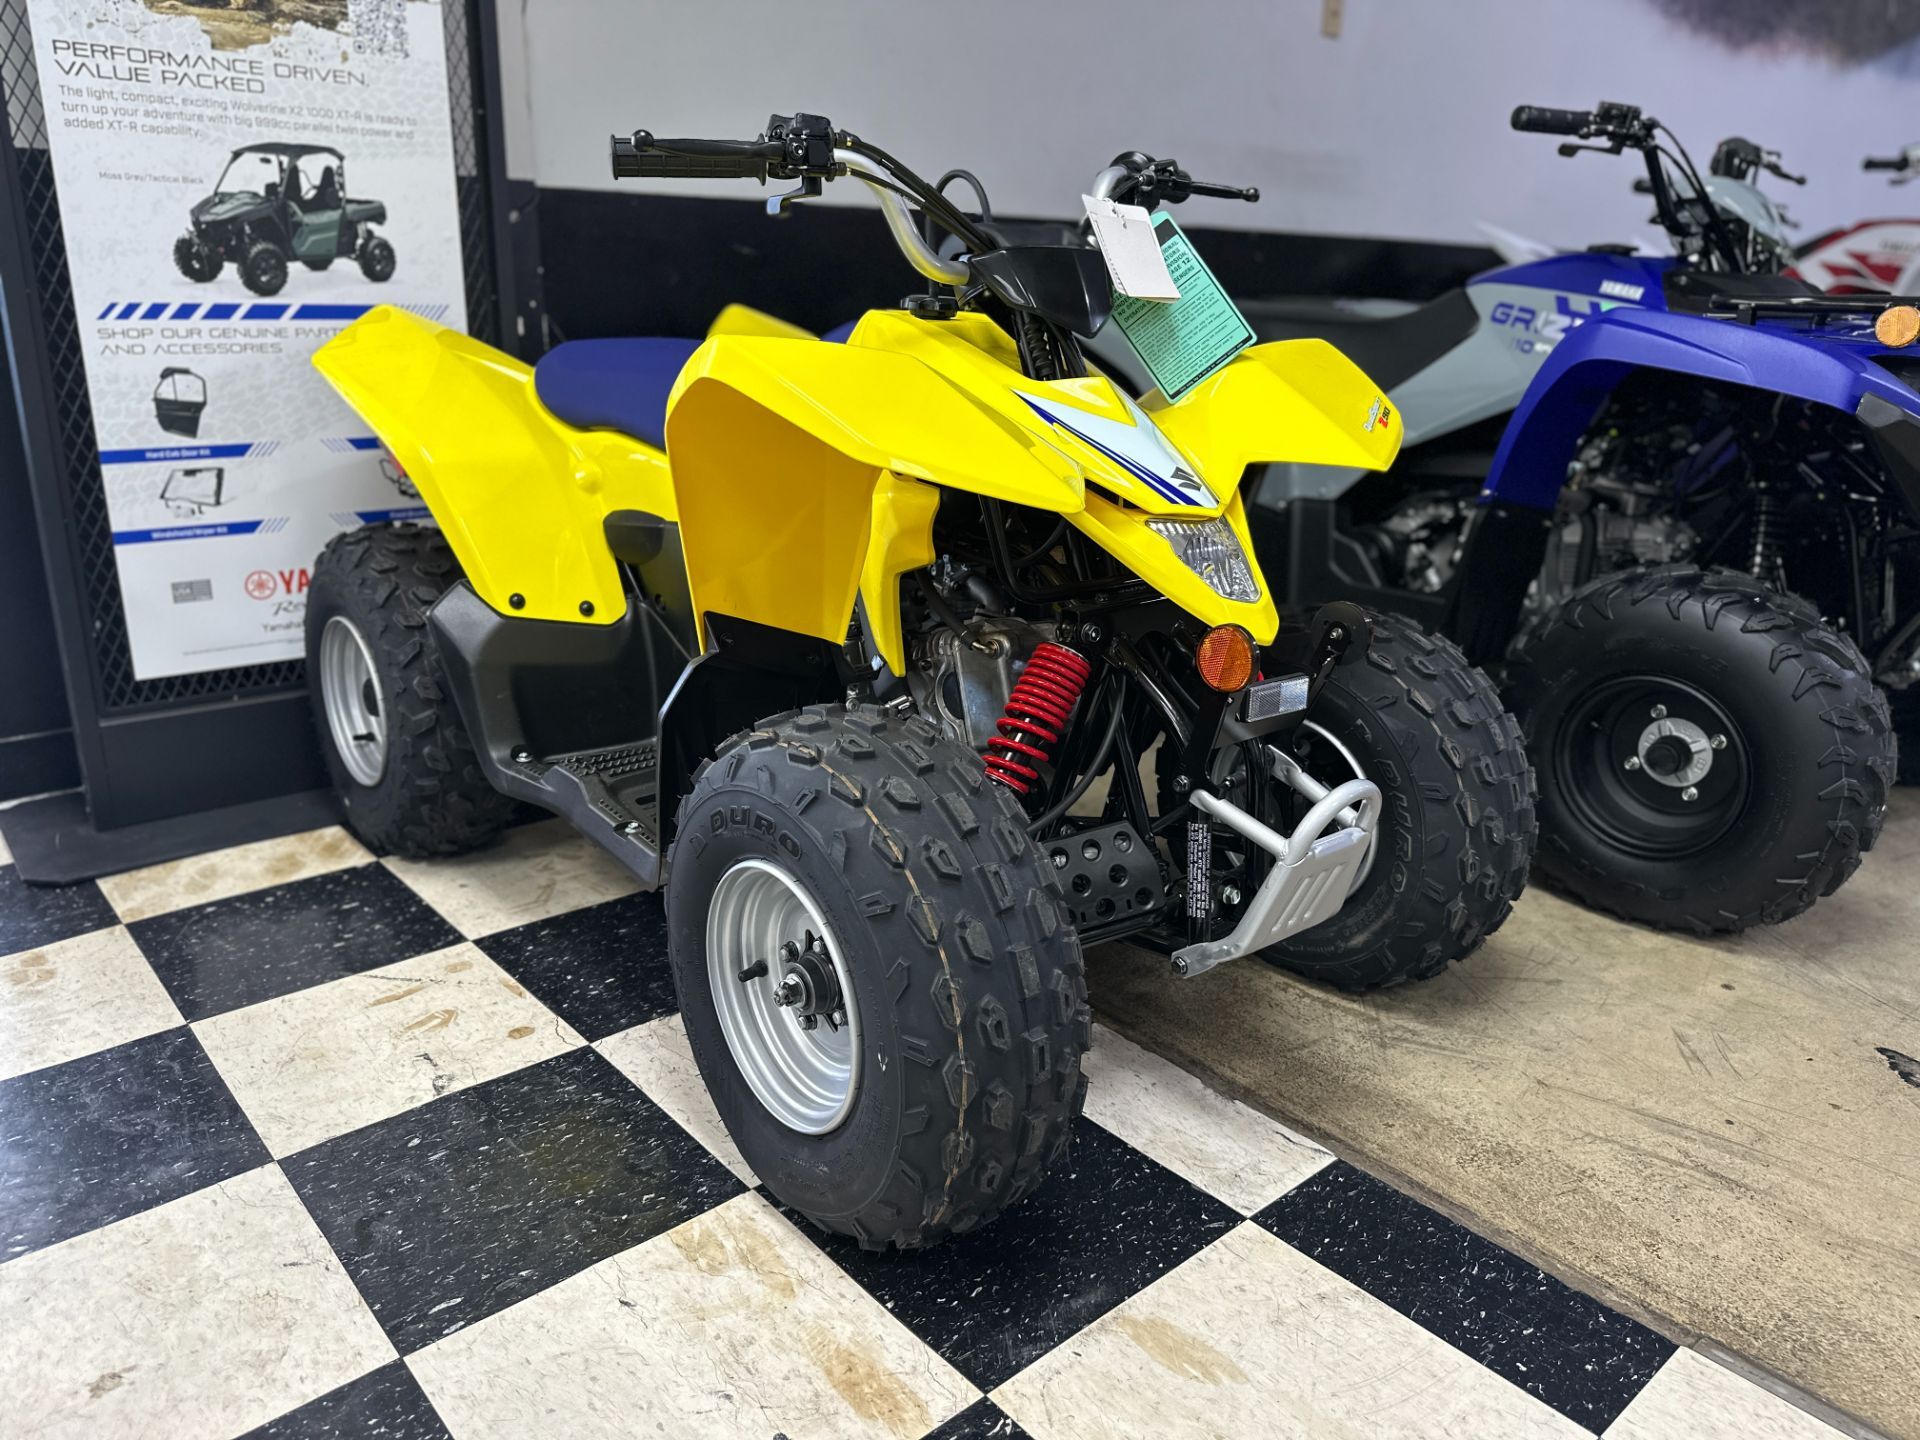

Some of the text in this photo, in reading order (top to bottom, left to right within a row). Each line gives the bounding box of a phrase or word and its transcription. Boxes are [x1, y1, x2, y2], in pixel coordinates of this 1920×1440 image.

[52, 39, 369, 87] PERFORMANCE DRIVEN.
[54, 59, 265, 94] VALUE PACKED
[58, 84, 83, 97] The
[87, 86, 118, 101] light,
[121, 90, 179, 107] compact,
[181, 96, 228, 111] exciting
[230, 101, 287, 114] Wolverine
[288, 104, 304, 116] X2
[306, 106, 334, 119] 1000
[336, 109, 364, 121] XT-R
[376, 113, 405, 126] ready
[406, 115, 418, 126] to
[61, 102, 89, 114] turn
[92, 105, 108, 118] up
[111, 106, 140, 120] your
[143, 108, 204, 123] adventure
[206, 113, 232, 125] with
[234, 116, 253, 129] big
[293, 120, 333, 133] parallel
[335, 123, 360, 135] twin
[360, 127, 393, 139] power
[395, 129, 415, 140] and
[63, 116, 202, 139] added XT-R capability.
[97, 327, 344, 339] SHOP OUR GENUINE PART
[101, 343, 283, 356] AND ACCESSORIES
[709, 805, 802, 860] DURO
[1373, 758, 1413, 893] DURO
